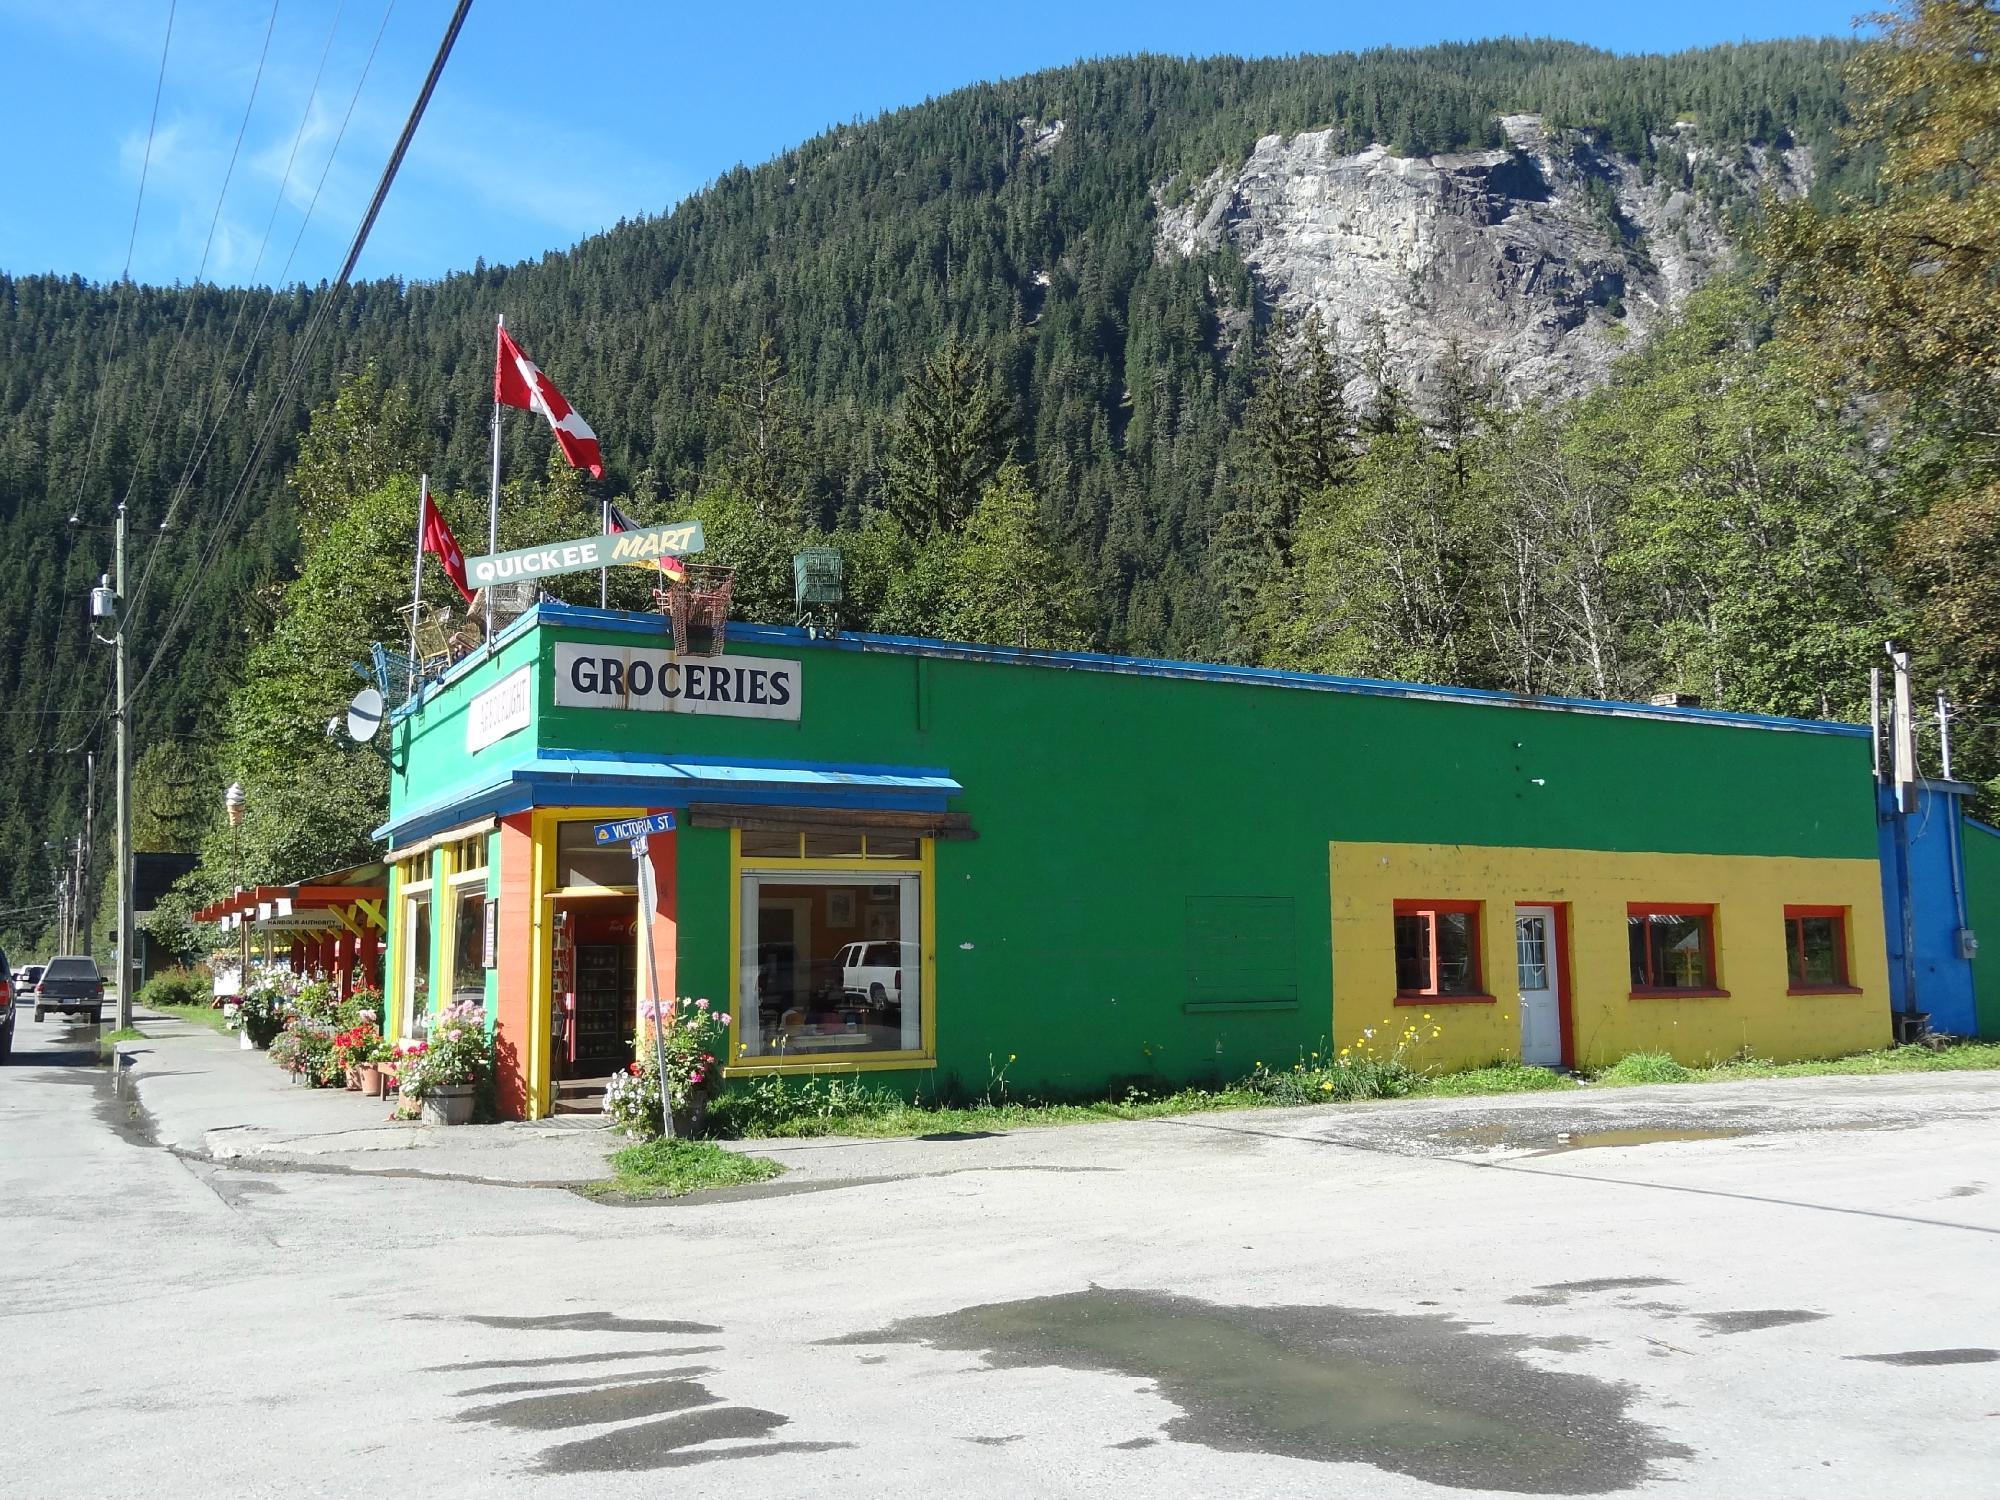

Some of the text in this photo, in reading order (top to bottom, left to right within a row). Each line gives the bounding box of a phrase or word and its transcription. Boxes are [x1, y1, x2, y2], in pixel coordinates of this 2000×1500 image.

[476, 526, 697, 583] QUICKEE MART
[571, 656, 790, 706] GROCERIES
[612, 815, 669, 839] VICTORIA ST
